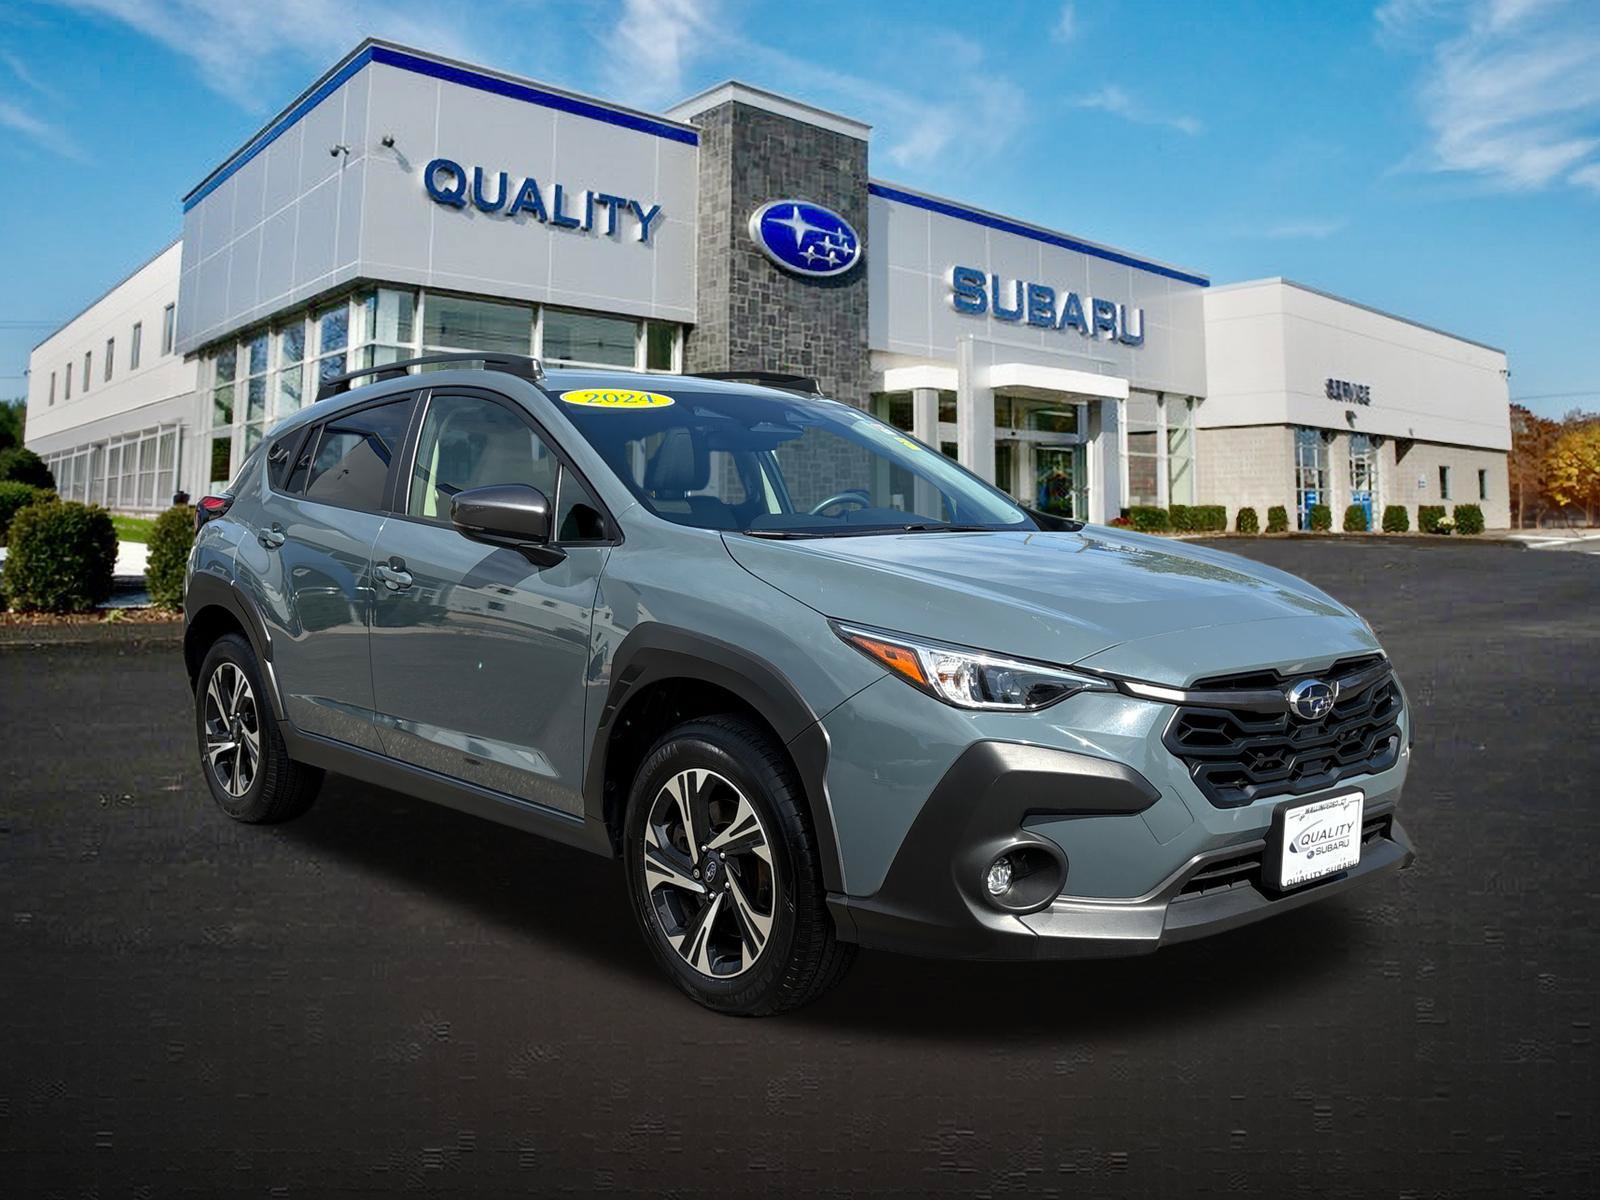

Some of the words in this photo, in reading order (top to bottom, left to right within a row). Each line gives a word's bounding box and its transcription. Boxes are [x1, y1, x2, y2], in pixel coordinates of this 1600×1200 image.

[424, 158, 662, 242] QUALITY
[949, 265, 1145, 347] SUBARU
[584, 393, 656, 404] 2024
[1301, 821, 1354, 846] QUALITY
[1315, 839, 1350, 856] SUBARU
